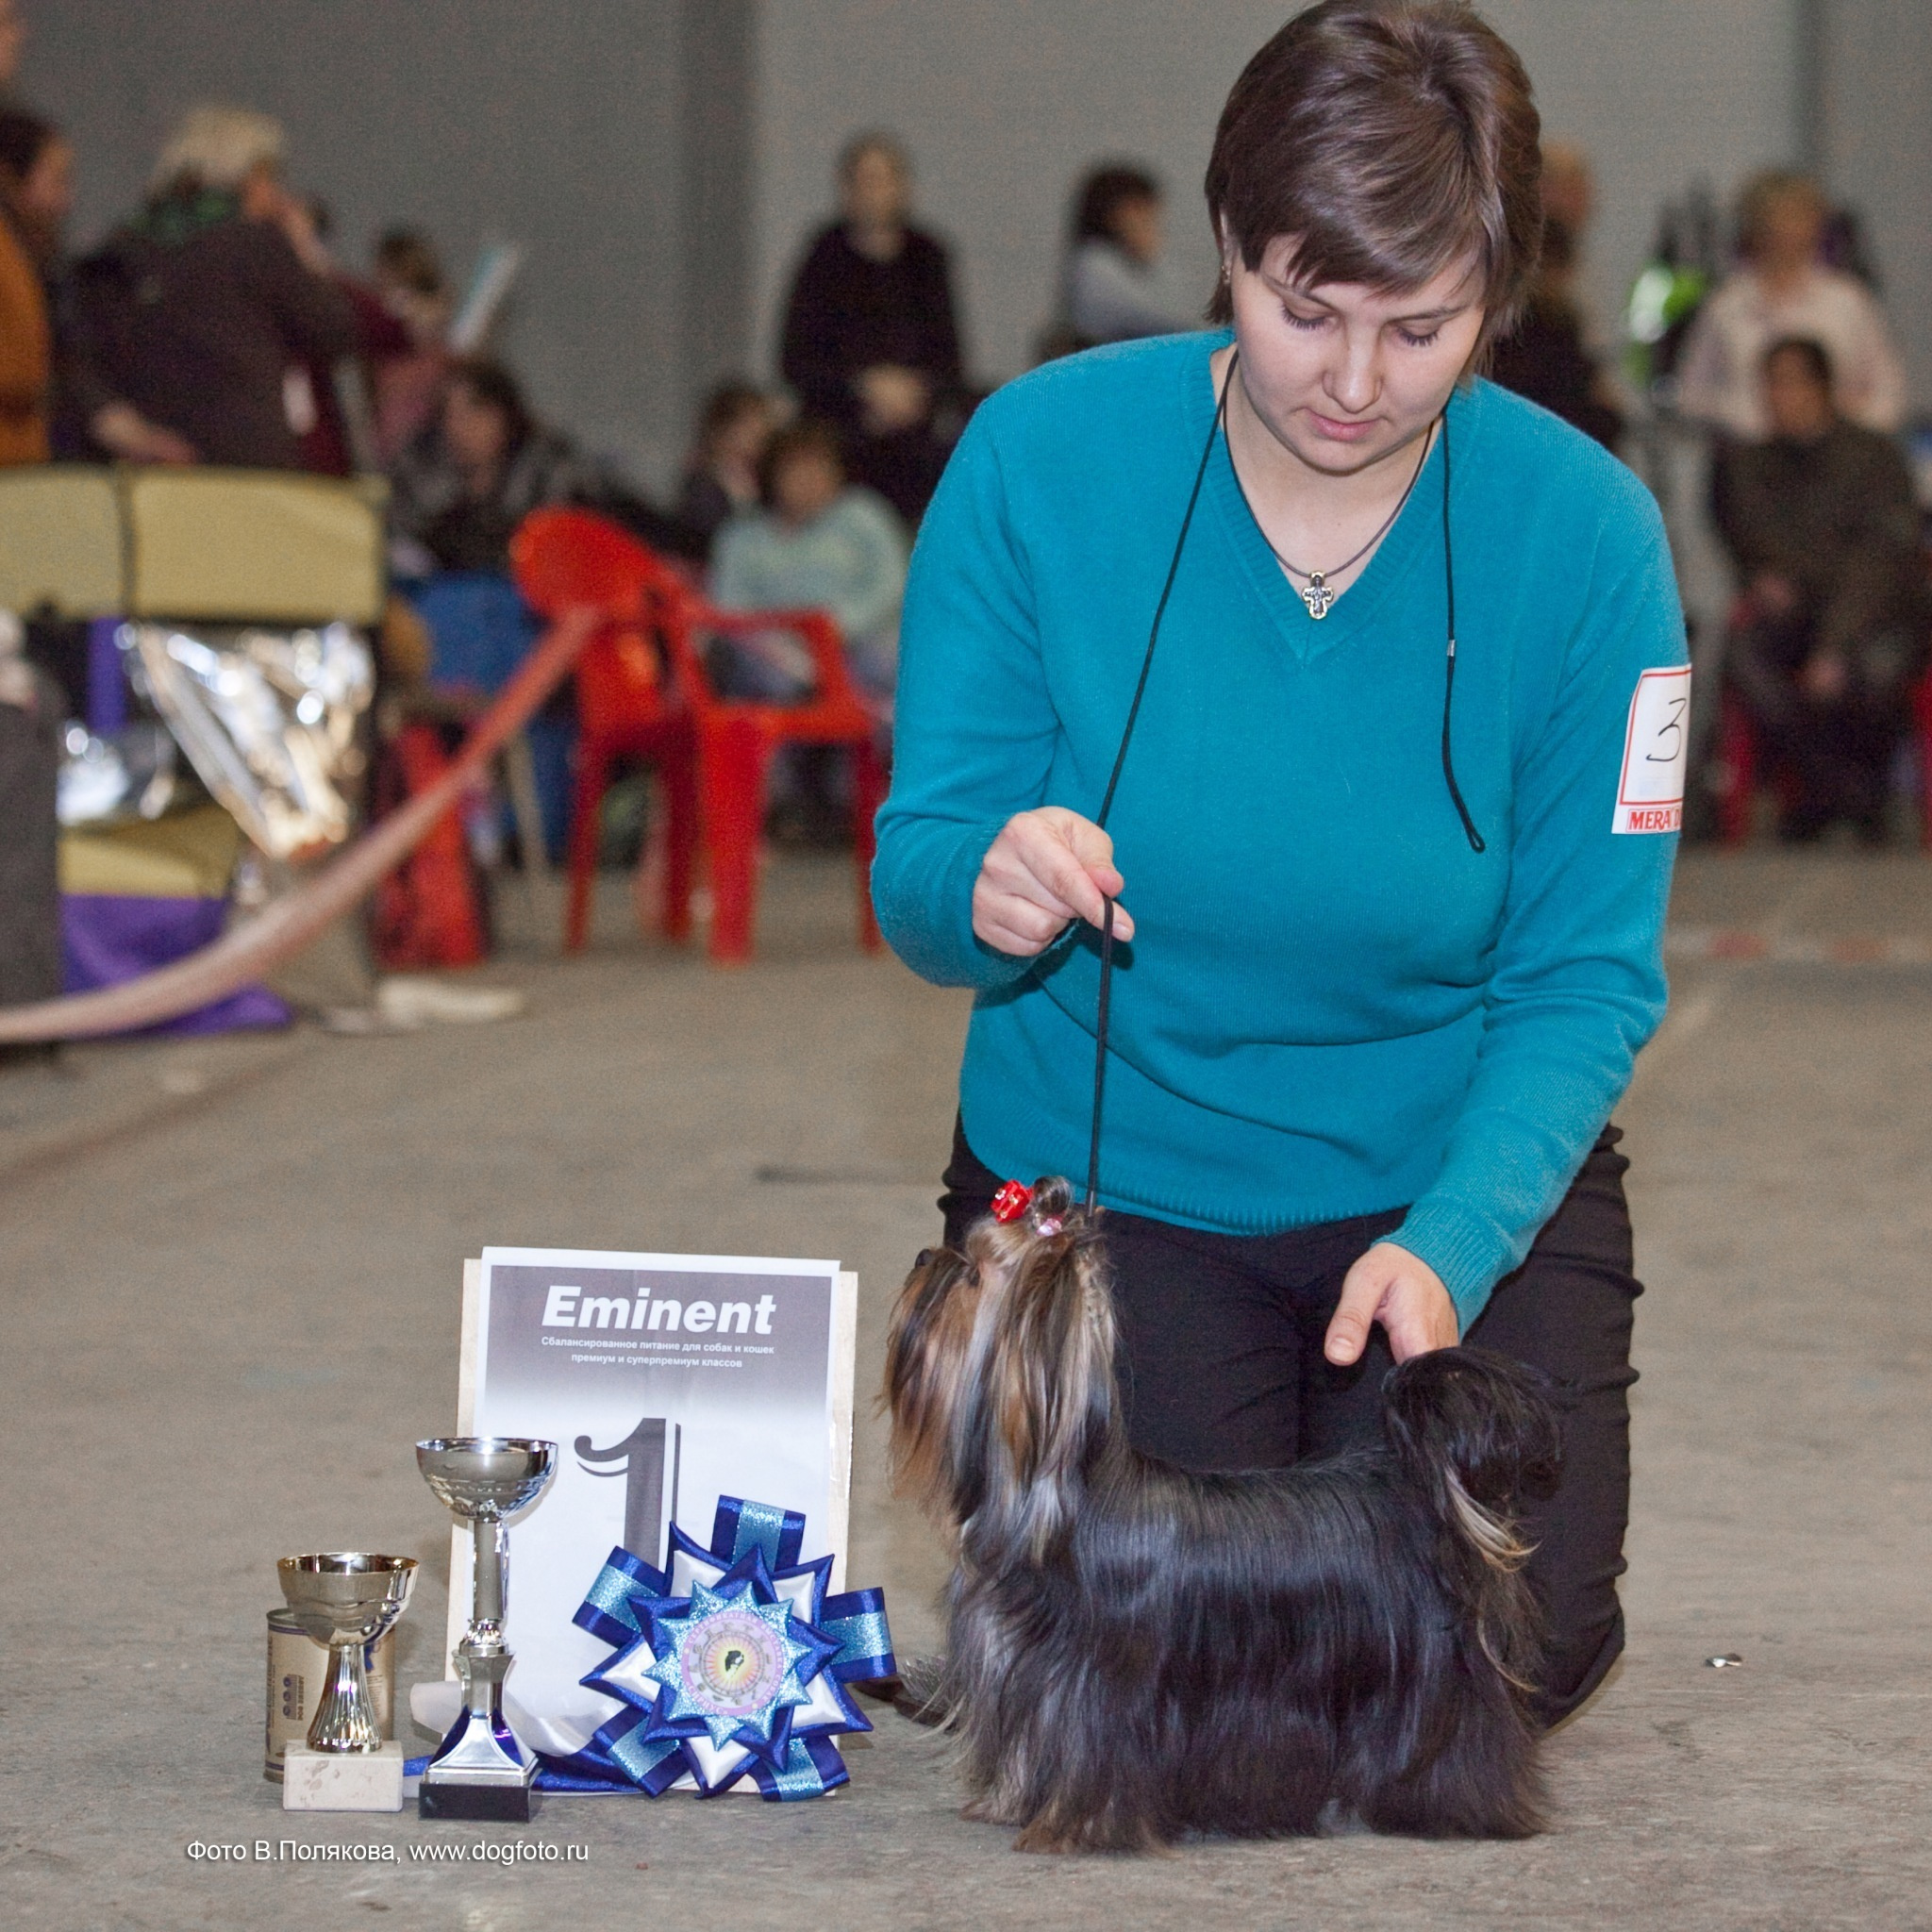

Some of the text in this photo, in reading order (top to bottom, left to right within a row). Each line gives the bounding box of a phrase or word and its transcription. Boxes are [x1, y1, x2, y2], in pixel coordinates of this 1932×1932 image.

[1646, 698, 1687, 762] 3
[1628, 809, 1671, 830] MERA
[541, 1285, 776, 1335] Eminent
[541, 1336, 774, 1355] Сбалансированное питание для собак и кошек
[571, 1354, 616, 1365] премиум
[626, 1356, 700, 1368] суперпремиум
[701, 1358, 743, 1368] классов
[574, 1417, 681, 1571] 1
